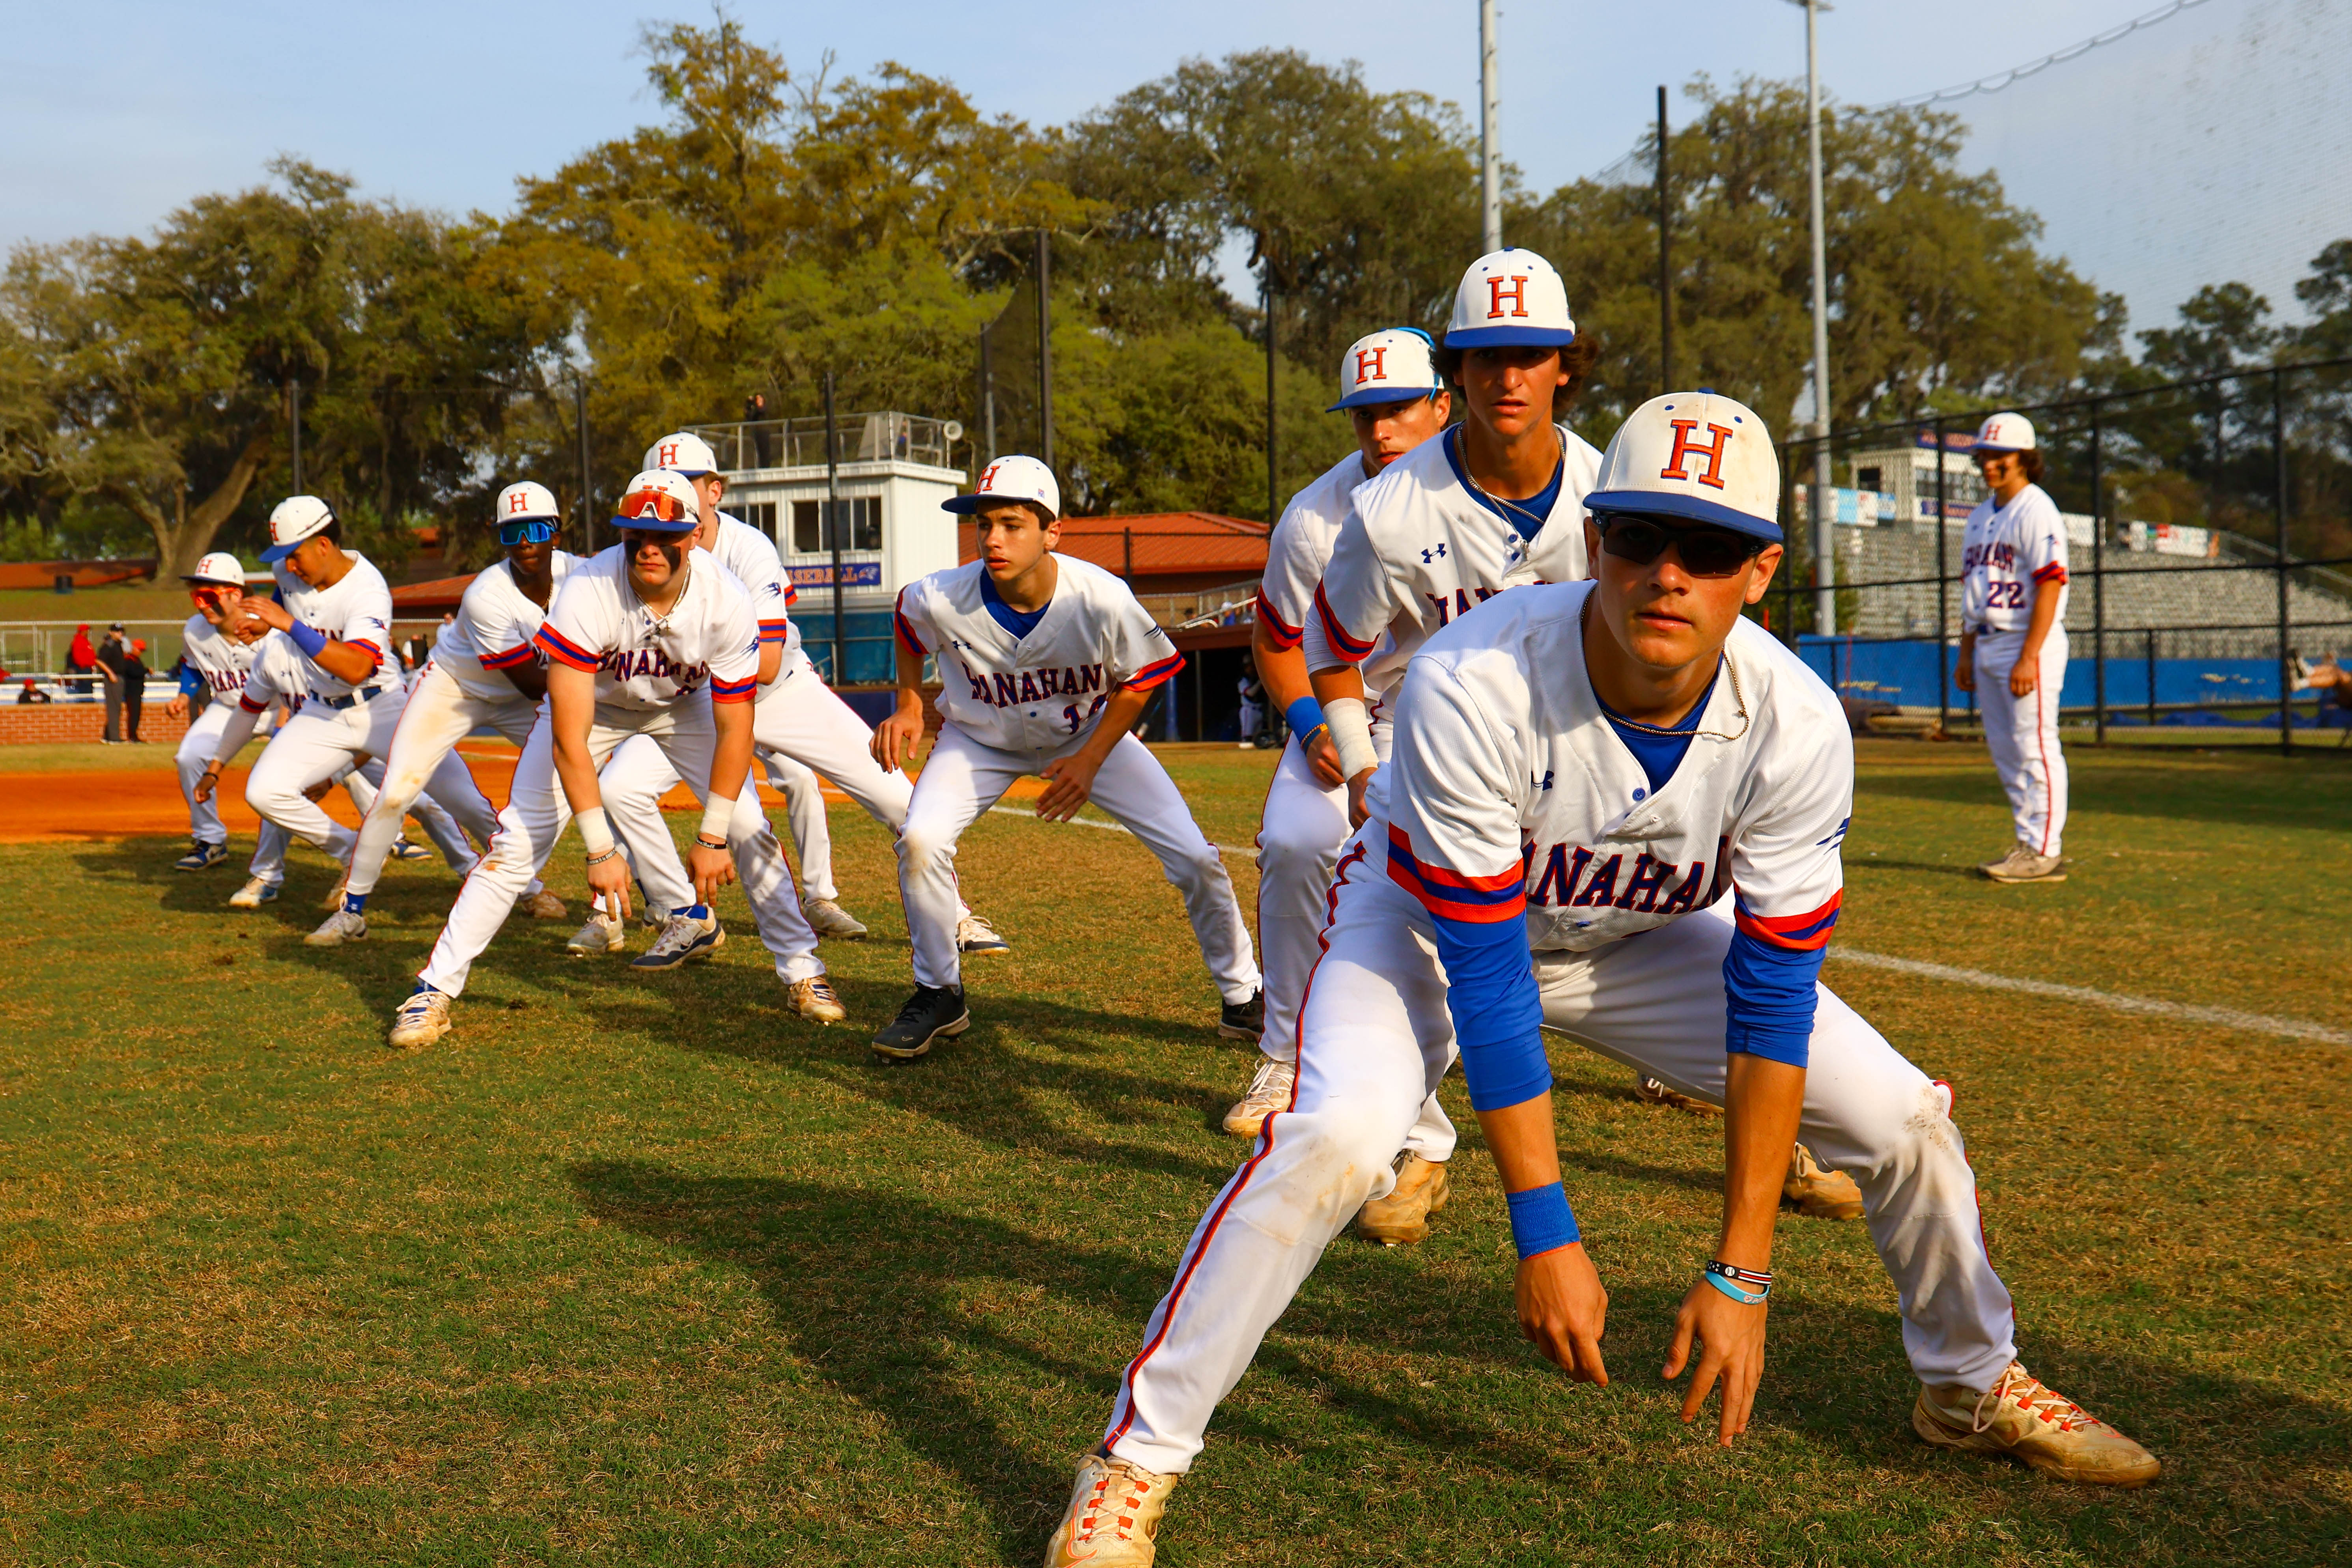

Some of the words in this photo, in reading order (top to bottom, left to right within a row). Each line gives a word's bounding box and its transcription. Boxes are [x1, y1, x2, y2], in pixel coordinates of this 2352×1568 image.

[1487, 276, 1528, 318] H
[1355, 347, 1387, 384] H
[1984, 424, 2001, 441] H
[658, 444, 679, 467] H
[1660, 419, 1733, 490] H
[975, 465, 1000, 495] H
[509, 493, 528, 513] H
[196, 558, 213, 573] H
[1987, 581, 2026, 609] 22
